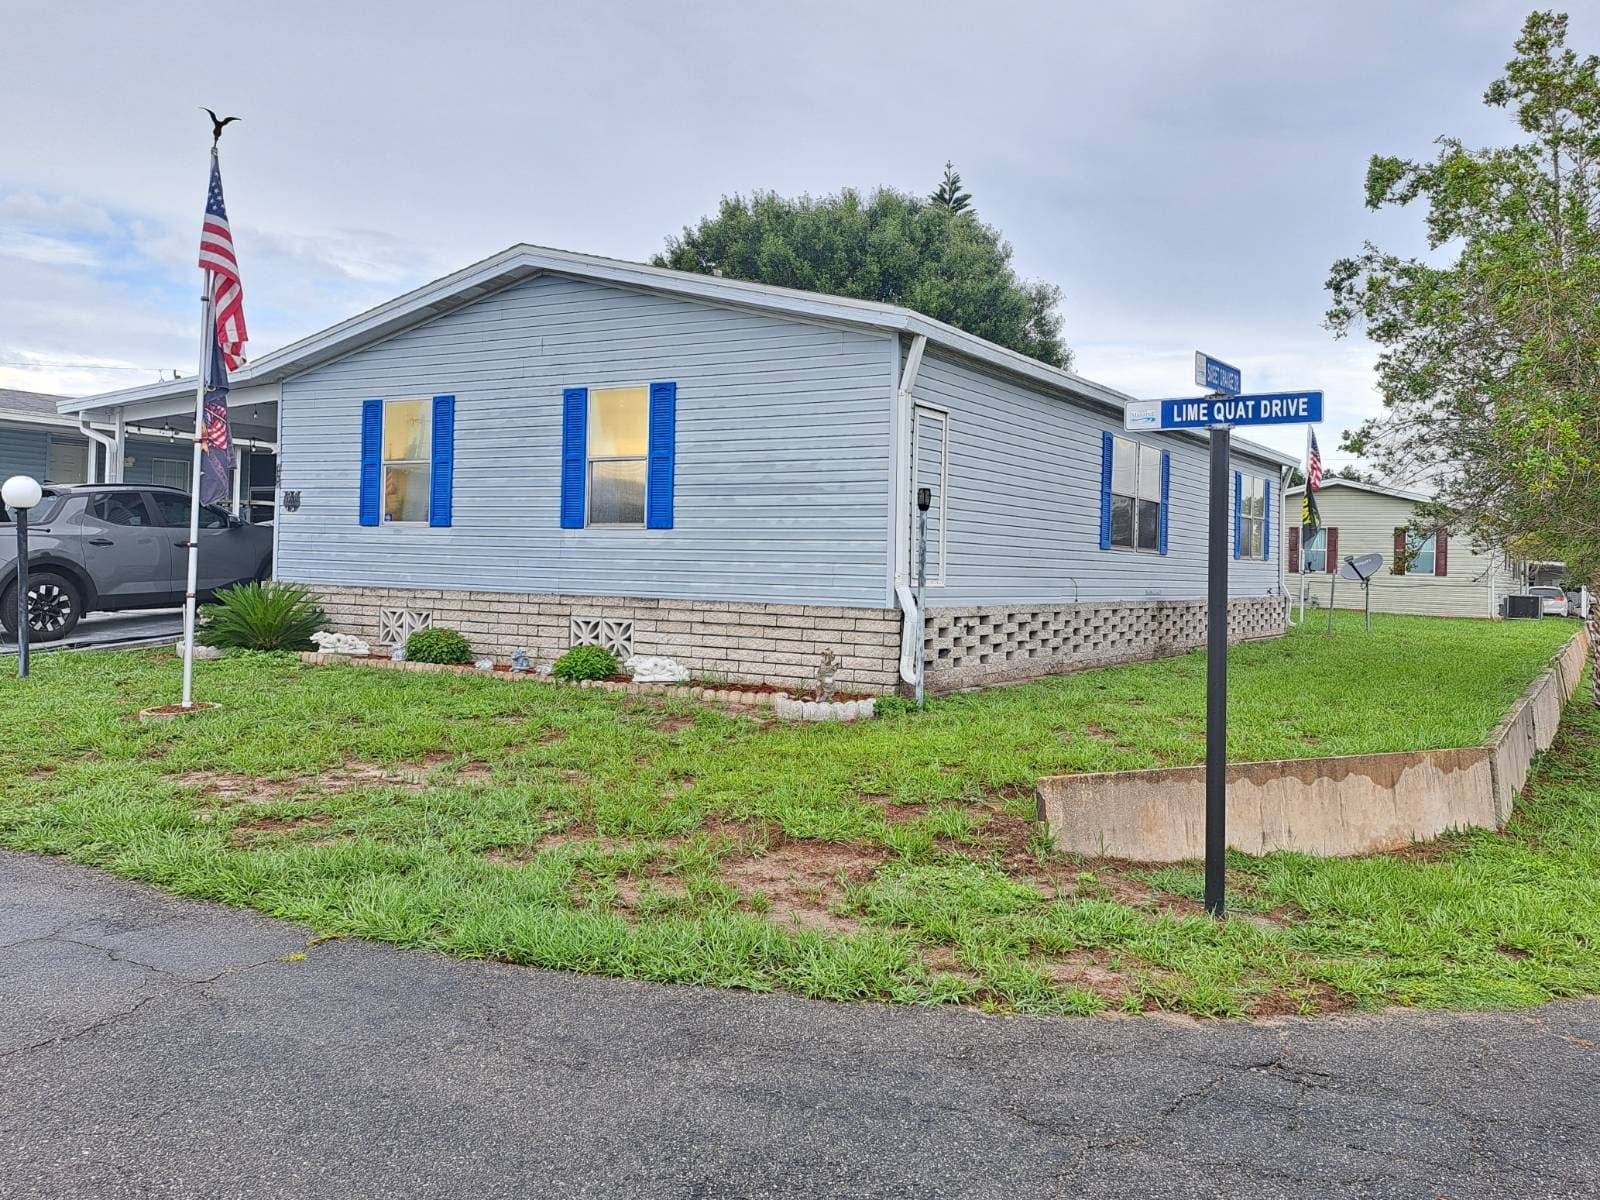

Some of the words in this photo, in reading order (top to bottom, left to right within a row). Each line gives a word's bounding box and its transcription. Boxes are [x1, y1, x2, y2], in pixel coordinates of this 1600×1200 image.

[1174, 403, 1208, 422] LIME
[1214, 401, 1255, 421] QUAT
[1260, 398, 1308, 418] DRIVE
